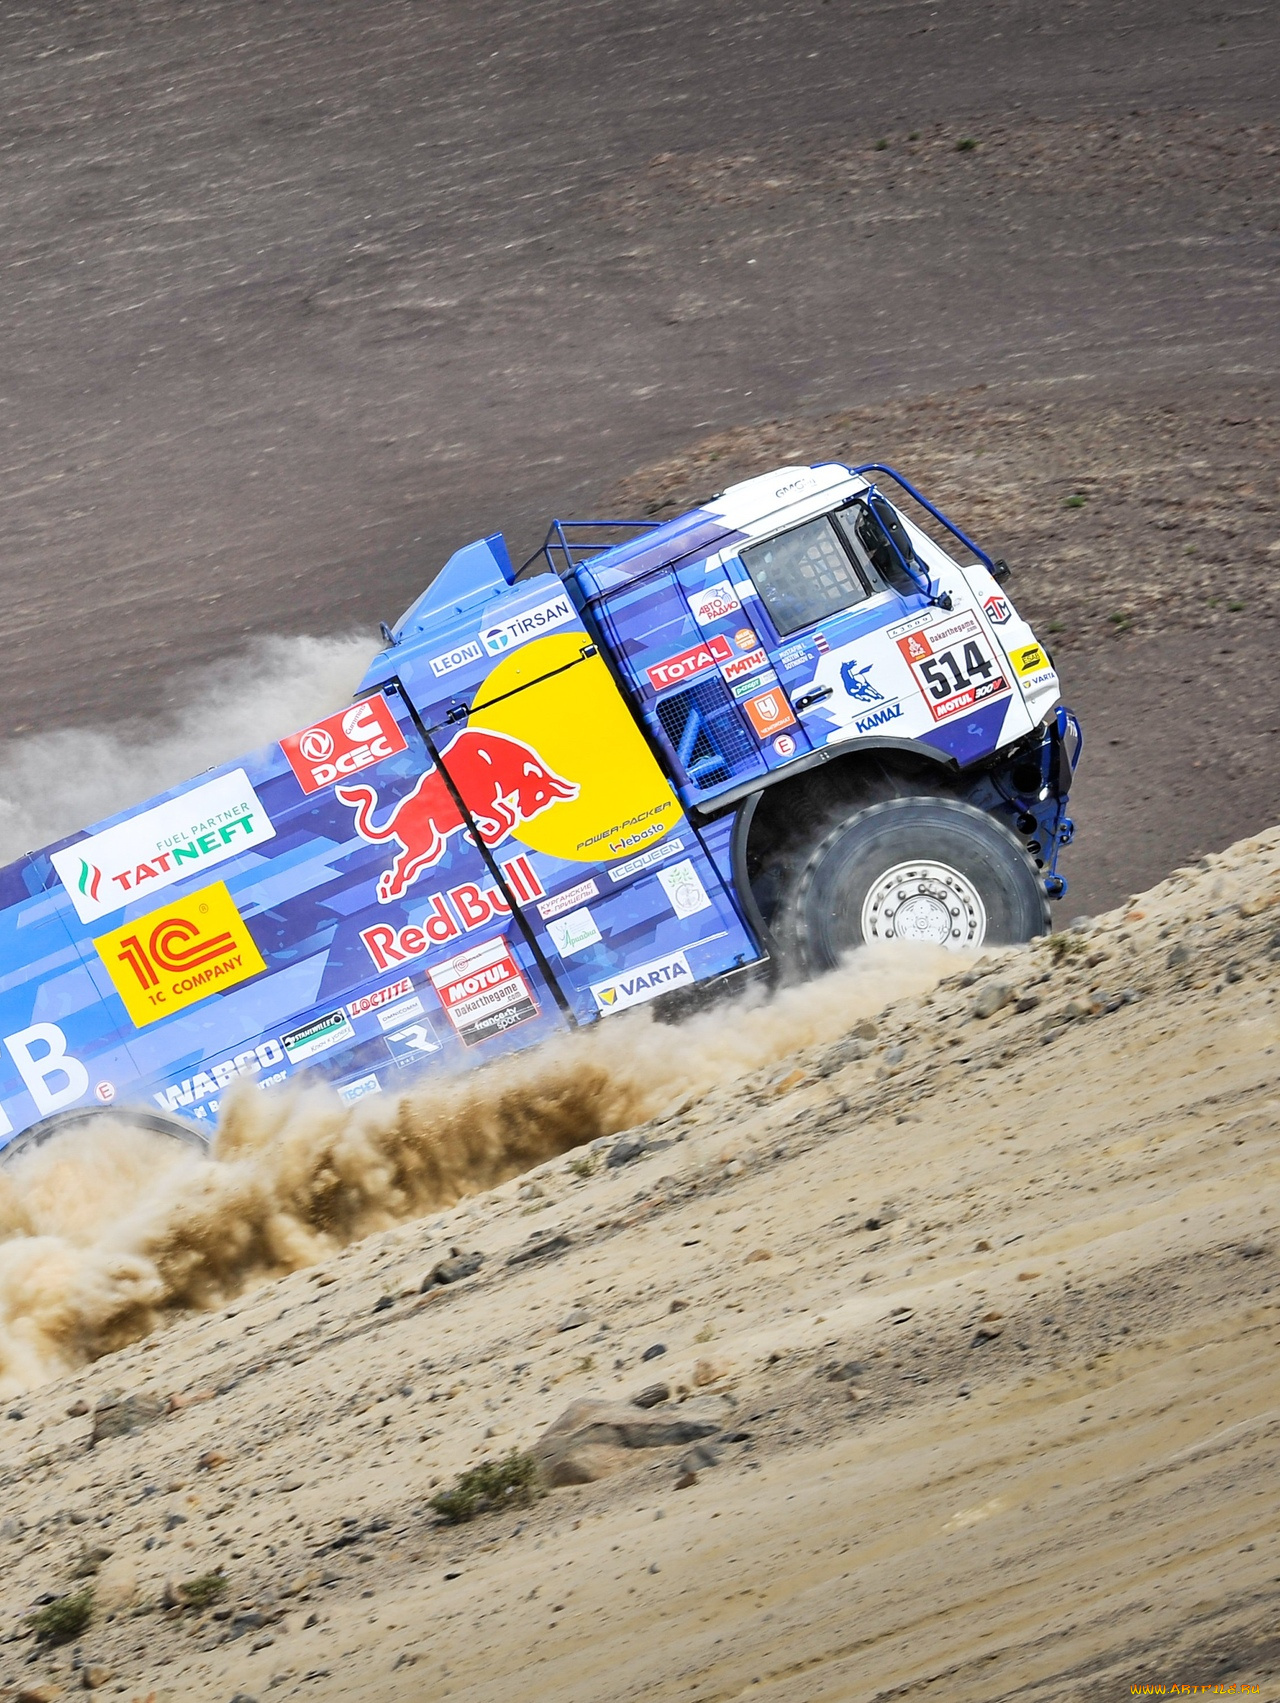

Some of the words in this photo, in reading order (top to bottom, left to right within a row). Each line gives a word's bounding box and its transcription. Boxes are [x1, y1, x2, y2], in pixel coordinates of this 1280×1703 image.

[507, 601, 569, 637] TİRSAN
[698, 599, 722, 616] АВТО
[707, 601, 739, 620] РАДИО
[433, 645, 479, 673] LEONI
[651, 647, 728, 682] TOTAL
[725, 651, 764, 678] МАТЧ!
[919, 640, 993, 700] 514
[1032, 672, 1055, 684] VARTA
[937, 693, 973, 717] MOTUL
[975, 678, 1003, 699] 300V
[855, 703, 904, 733] KAMAZ
[310, 736, 393, 786] DCEC
[778, 739, 791, 753] E
[156, 831, 190, 851] FUEL
[191, 802, 250, 835] PARTNER
[609, 823, 664, 852] Webasto
[112, 813, 255, 891] TATNEFT
[612, 841, 680, 878] ICEQUEEN
[363, 897, 458, 969] Red
[451, 857, 542, 928] Bull
[540, 883, 592, 910] КУРГАНСКИЕ
[554, 890, 594, 912] ПРИЦЕПЫ
[148, 991, 167, 1006] 1C
[172, 955, 244, 995] COMPANY
[448, 963, 510, 1003] MOTUL
[619, 962, 687, 996] VARTA
[351, 979, 410, 1016] LOCTITE
[454, 983, 518, 1018] Dakarthegame
[497, 1014, 522, 1030] sport
[98, 1084, 113, 1100] E
[153, 1039, 285, 1112] WABCO
